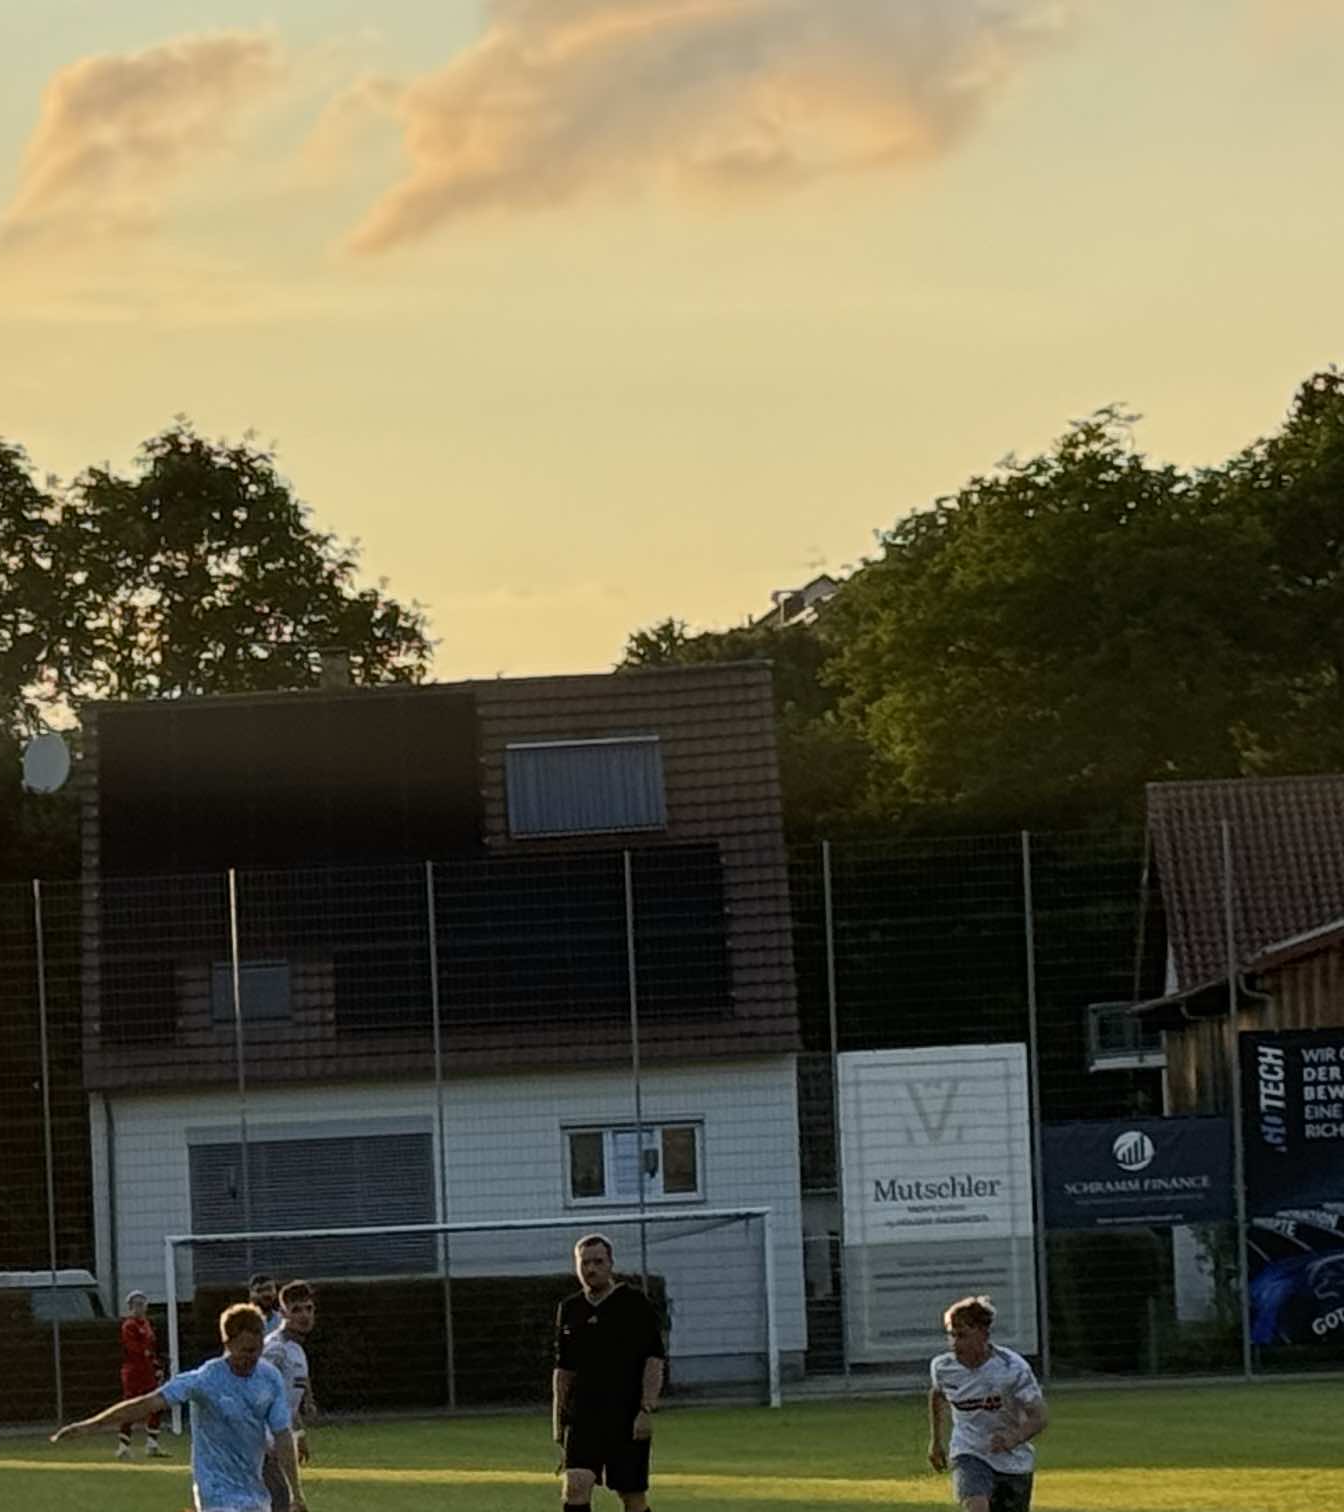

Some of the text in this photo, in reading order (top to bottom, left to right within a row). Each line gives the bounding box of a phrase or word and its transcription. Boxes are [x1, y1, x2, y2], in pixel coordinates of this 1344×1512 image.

[1301, 1046, 1336, 1063] WIR
[1302, 1066, 1342, 1082] DER
[1303, 1084, 1344, 1101] BEW
[1304, 1104, 1344, 1120] EINE
[873, 1173, 1002, 1202] Mutschler
[1064, 1175, 1210, 1195] SCHRAMM FINANCE
